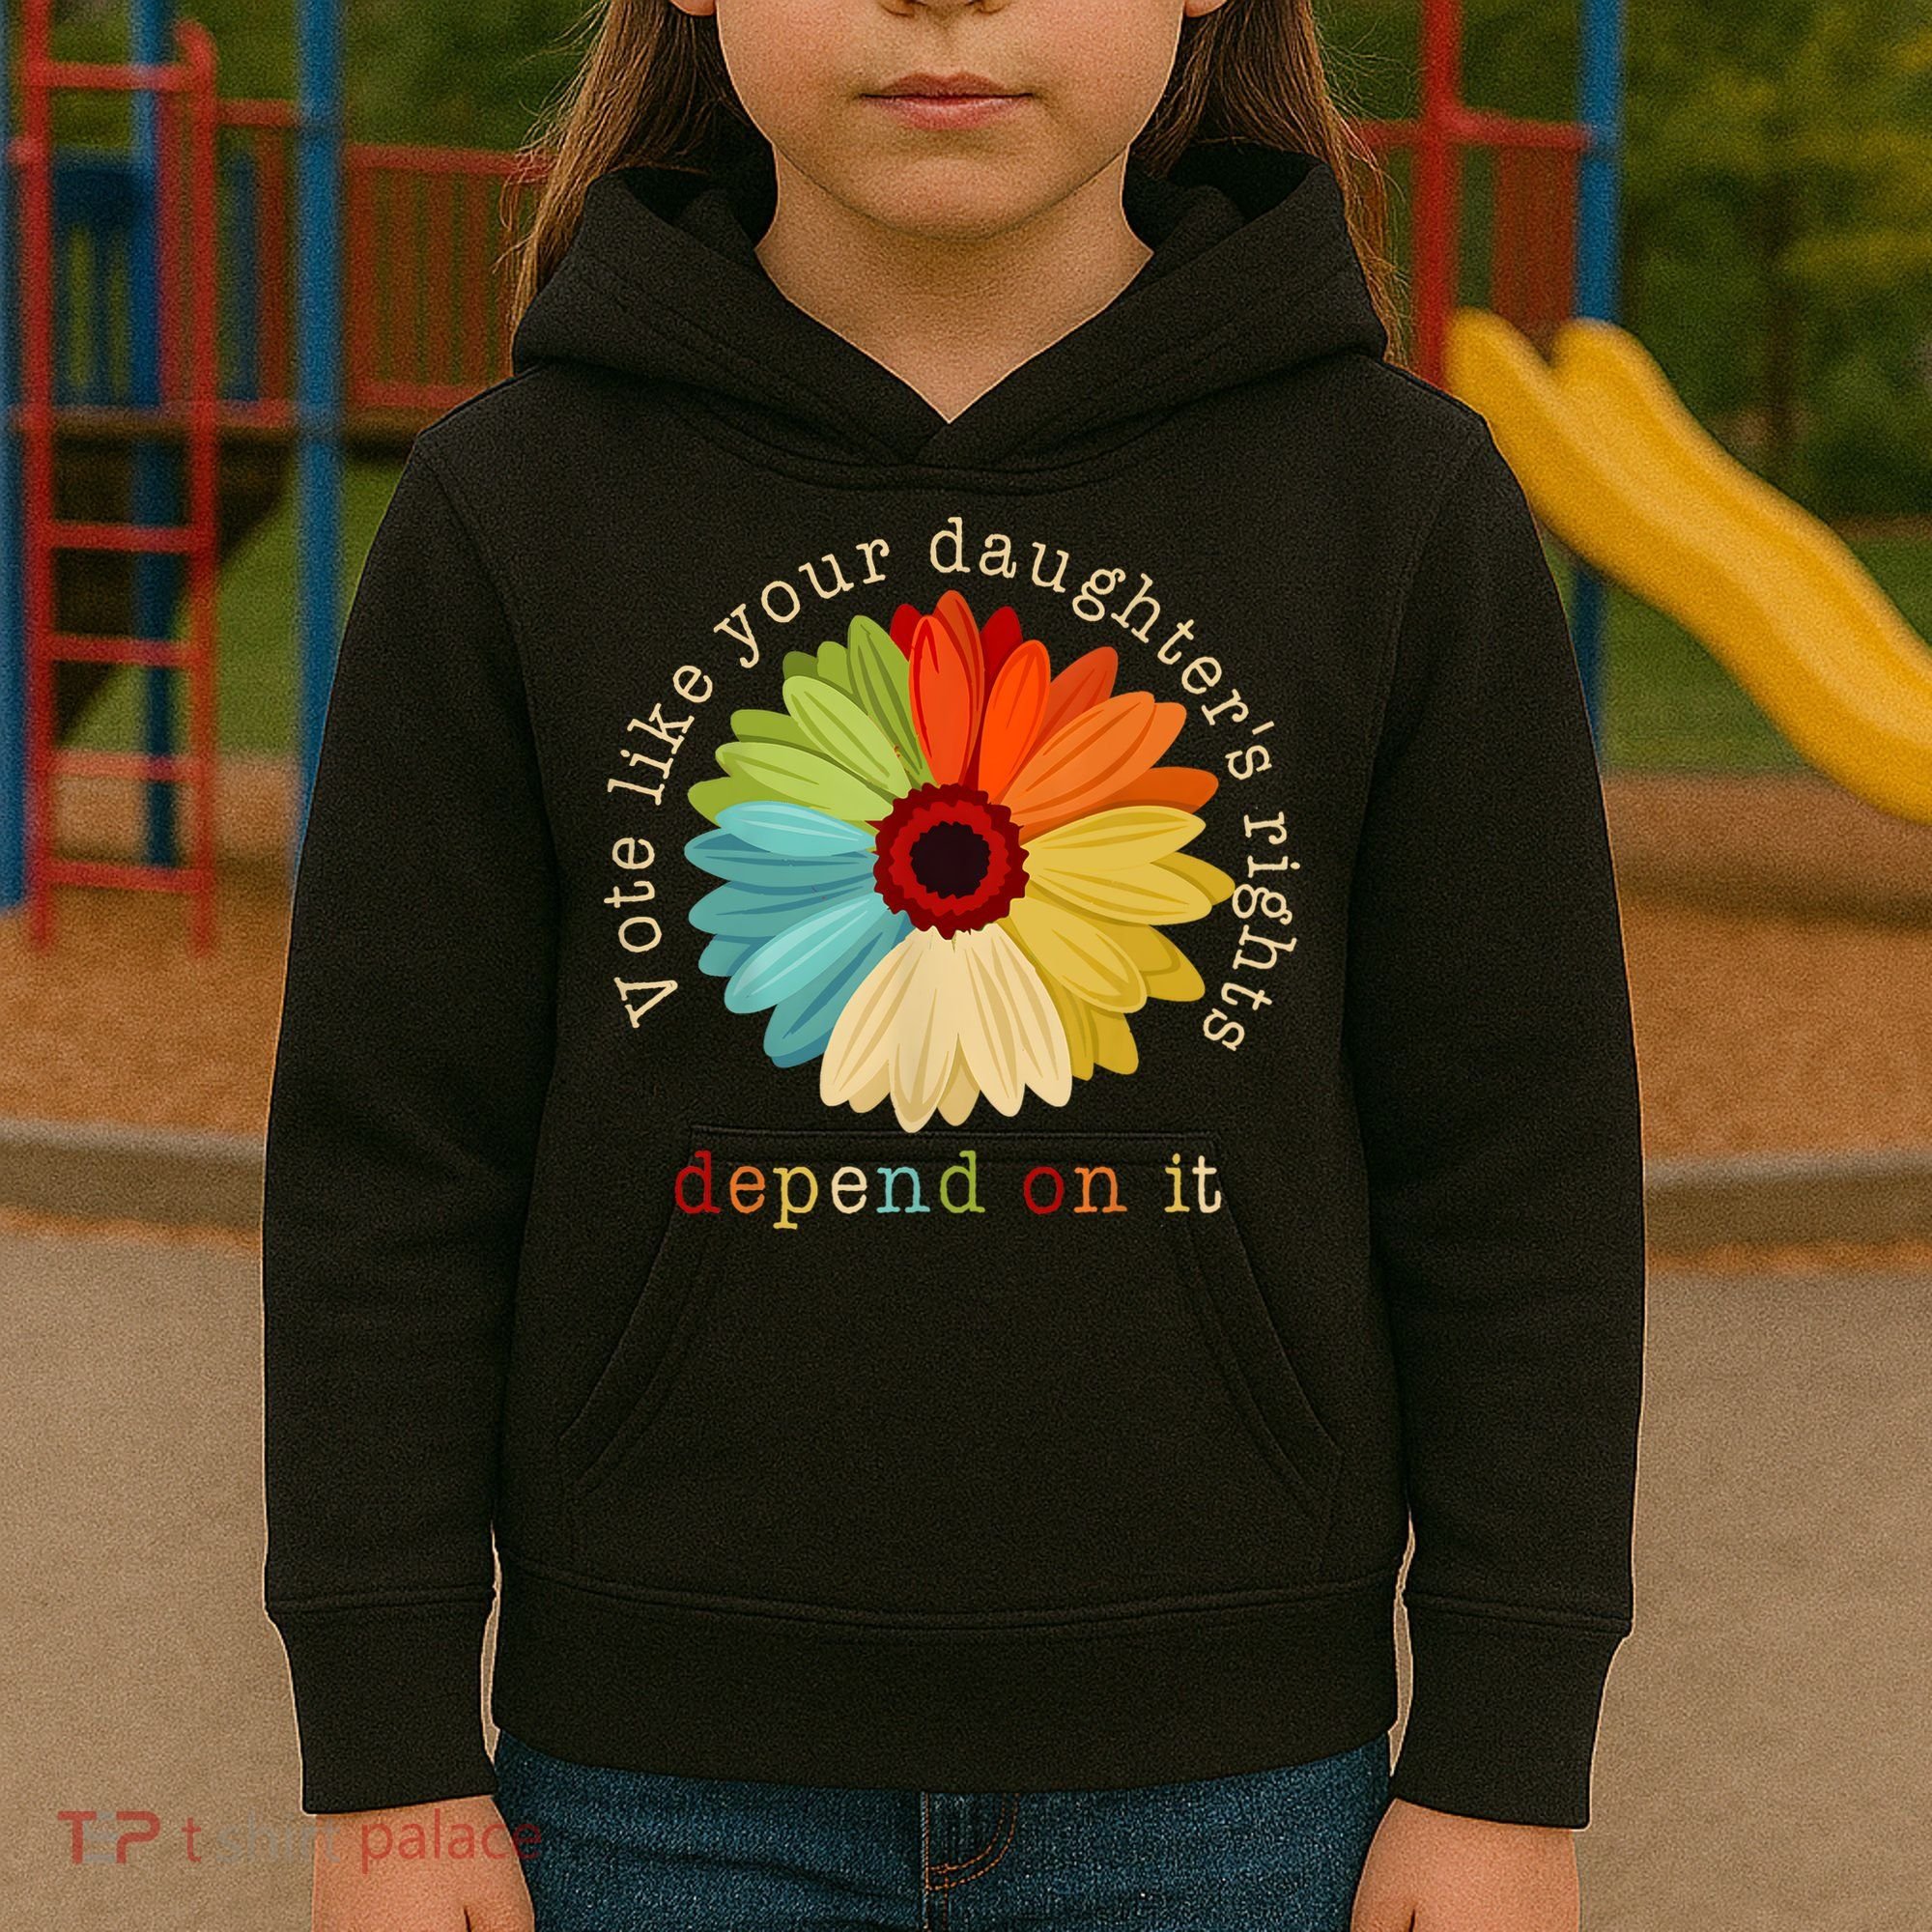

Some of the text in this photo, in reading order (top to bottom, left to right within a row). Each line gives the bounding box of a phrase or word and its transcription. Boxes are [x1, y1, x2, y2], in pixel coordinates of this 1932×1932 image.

[608, 666, 713, 806] like
[714, 539, 890, 668] your
[930, 517, 1274, 780] daughter's
[1203, 811, 1300, 1051] rights
[675, 1151, 1221, 1230] depend on it
